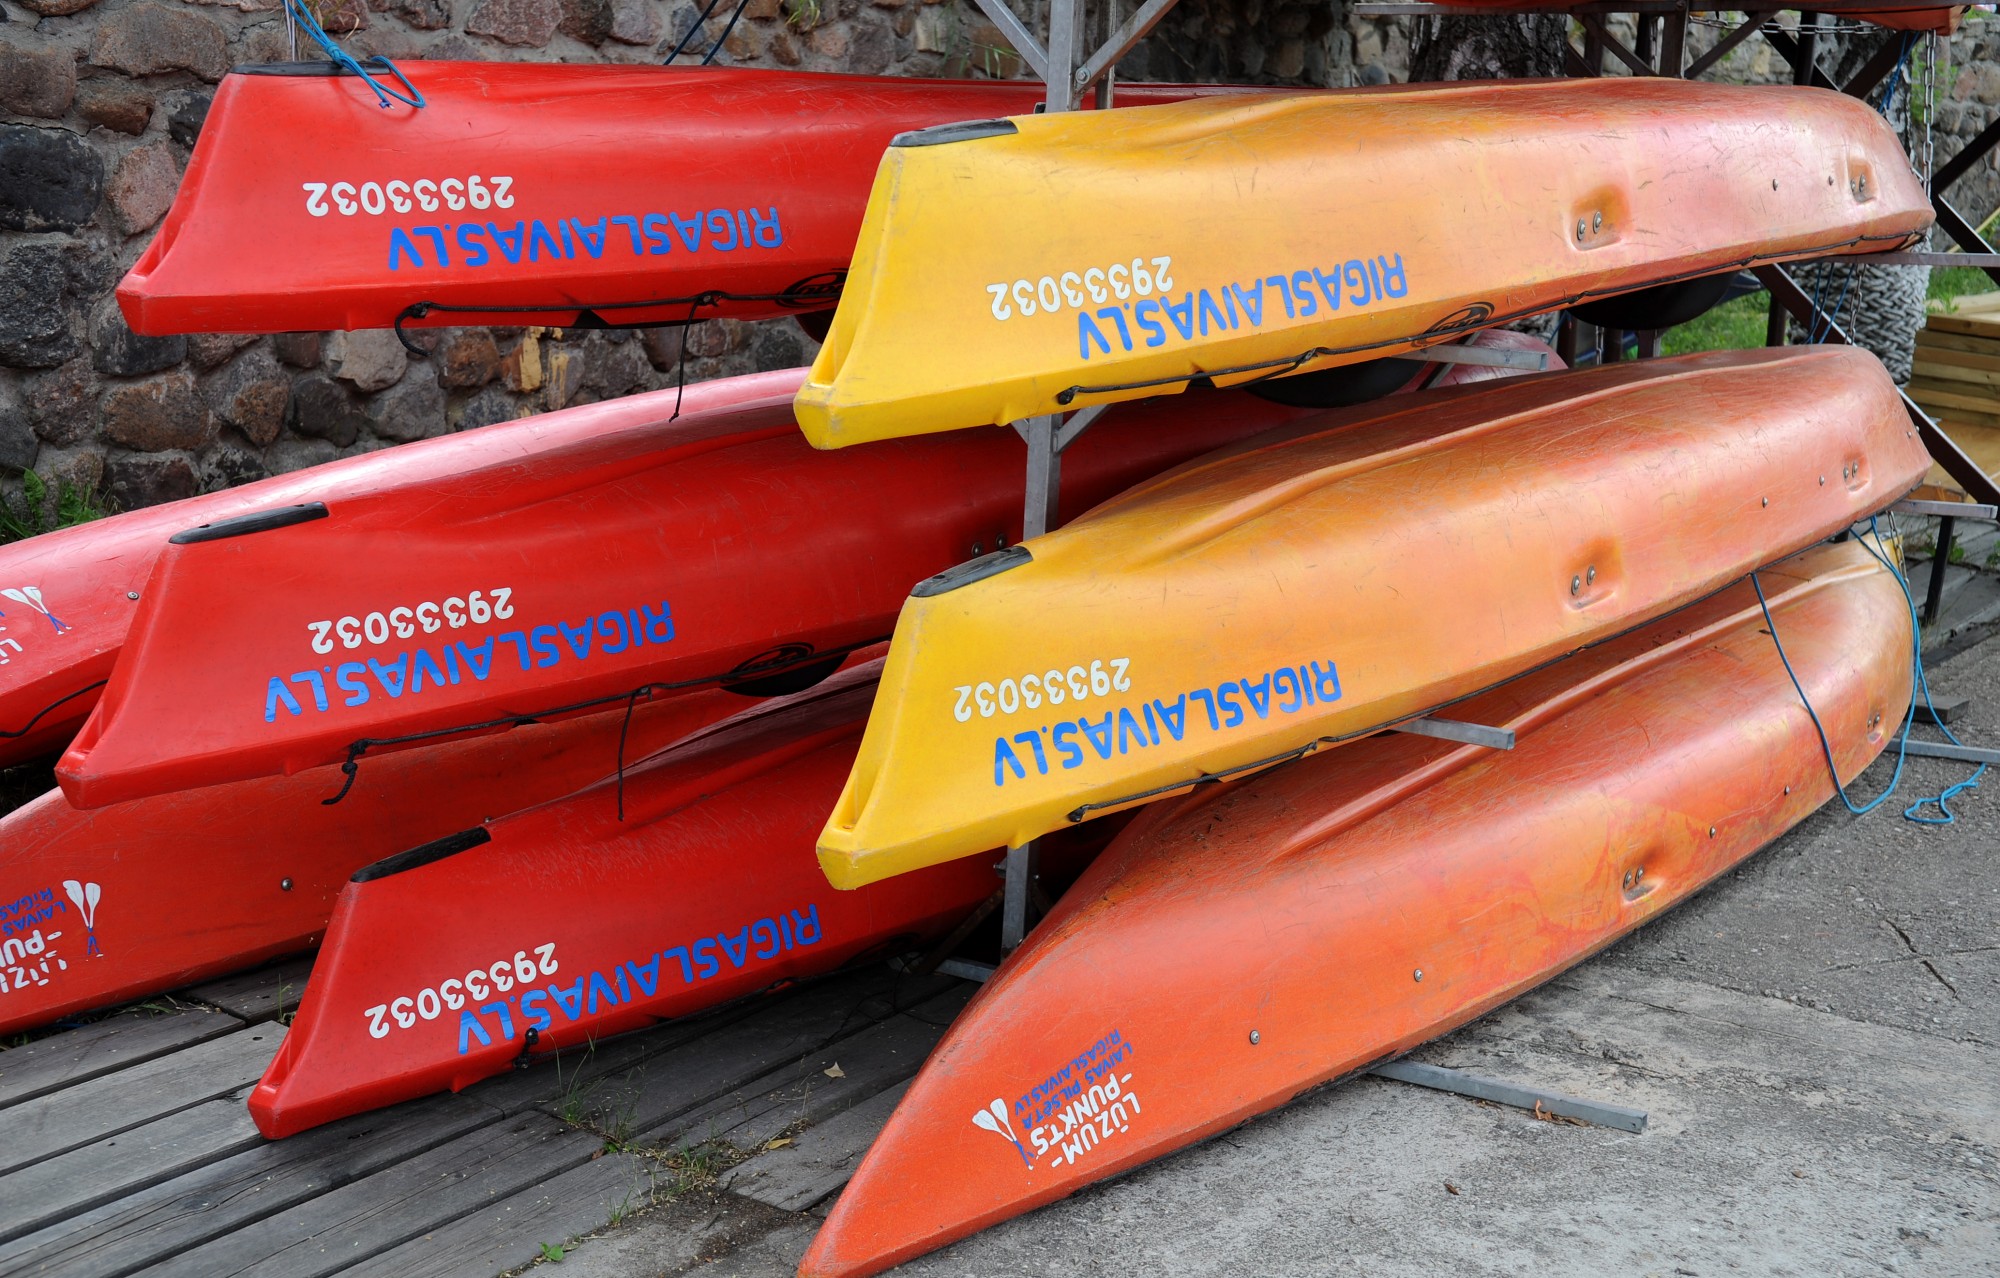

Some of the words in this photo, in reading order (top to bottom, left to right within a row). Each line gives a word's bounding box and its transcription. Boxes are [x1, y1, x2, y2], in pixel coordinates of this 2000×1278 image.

[303, 175, 514, 217] 29333032
[388, 206, 783, 271] RIGASLAIVAS.LV
[987, 255, 1173, 321] 29333032
[1078, 253, 1409, 360] RIGASLAIVAS.LV
[308, 587, 514, 655] 29333032
[264, 600, 676, 723] RIGASLAIVAS.LV
[953, 657, 1132, 723] 29333032
[994, 659, 1343, 787] RIGASLAIVAS.LV
[2, 901, 67, 937] LAIVAS
[364, 943, 559, 1039] 29333032
[457, 903, 823, 1055] RIGASLAIVAS.LV
[1084, 1042, 1134, 1086] LAIVAS
